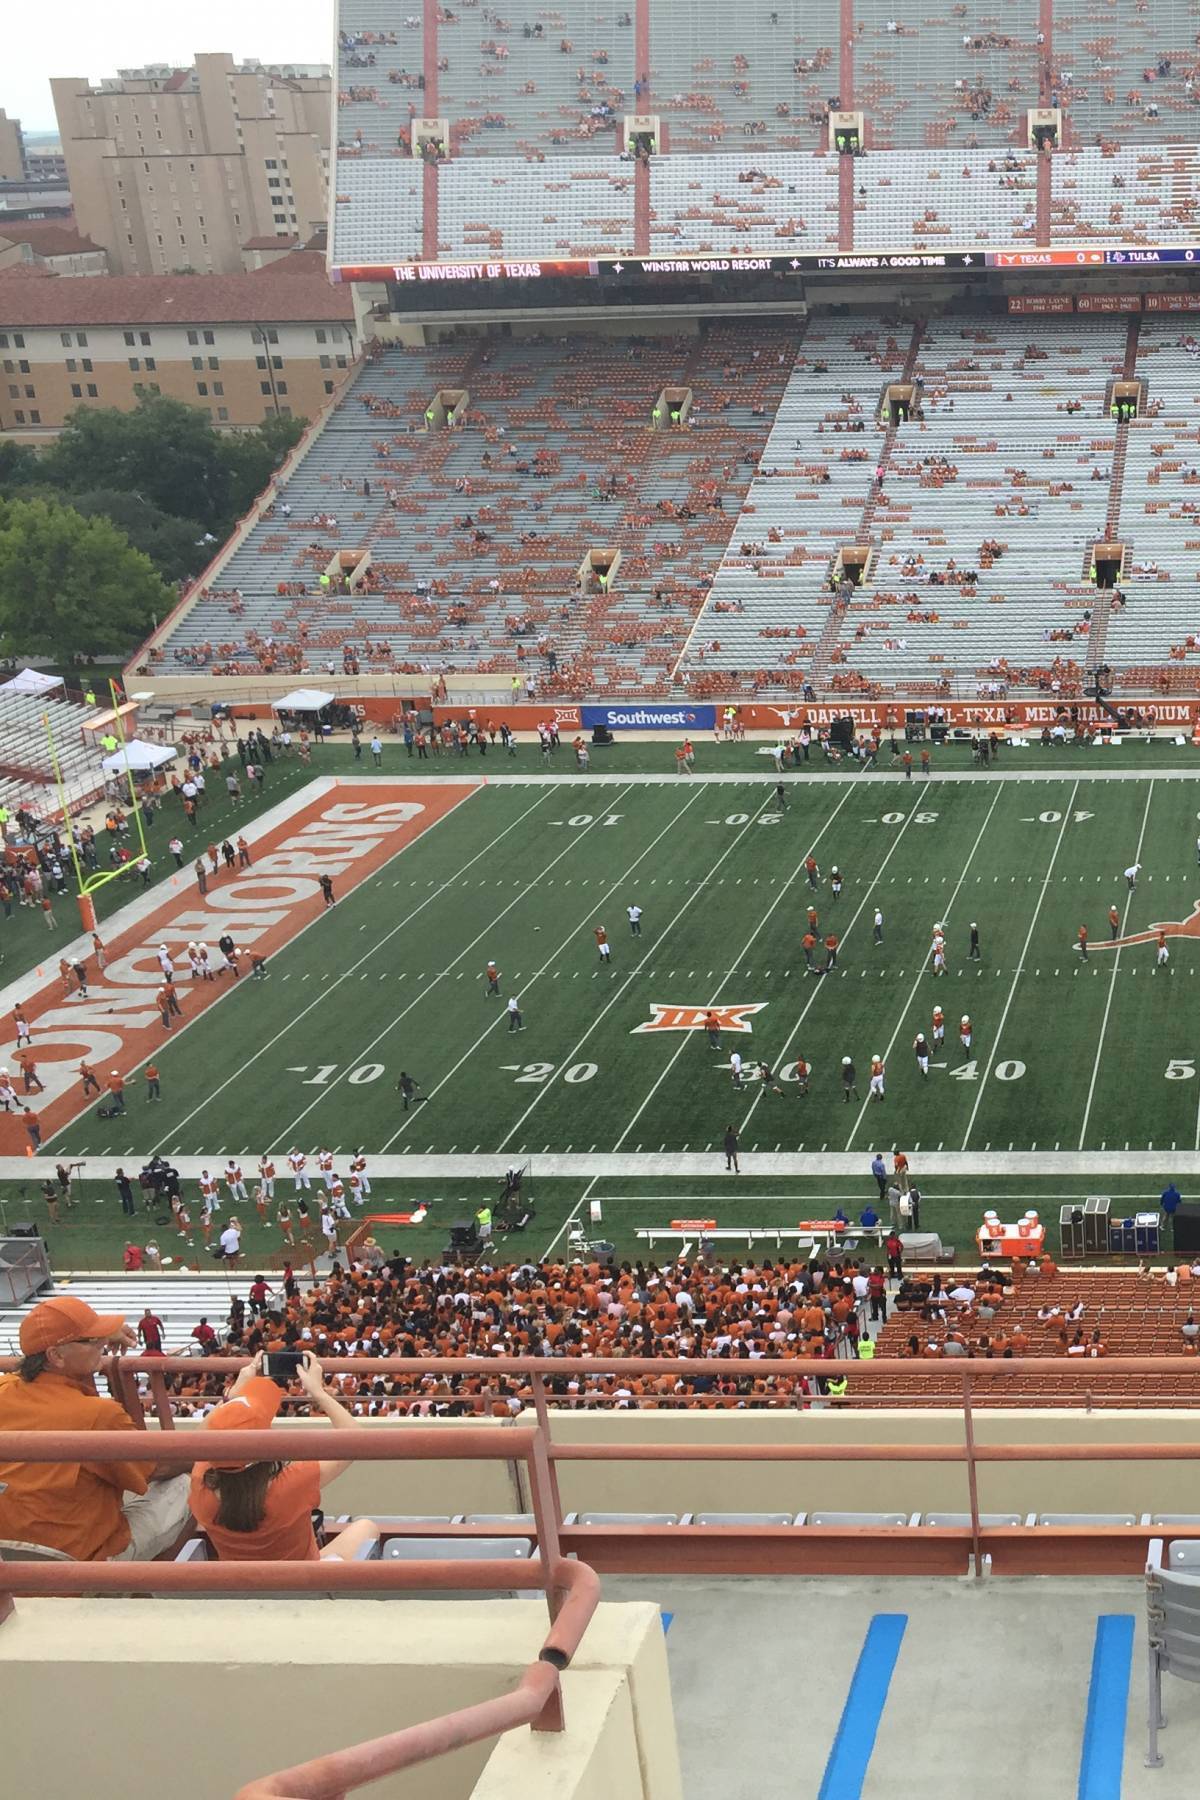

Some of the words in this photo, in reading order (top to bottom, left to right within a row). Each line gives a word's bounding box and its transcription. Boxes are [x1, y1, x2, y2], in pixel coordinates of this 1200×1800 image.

[818, 258, 836, 268] IT'S
[837, 257, 879, 267] ALWAYS
[880, 258, 889, 267] A
[889, 256, 920, 267] GOOD
[920, 256, 945, 266] TIME
[1020, 254, 1052, 263] TEXAS
[1076, 253, 1085, 263] 0
[1128, 252, 1160, 261] TULSA
[1185, 251, 1194, 260] 0
[641, 261, 689, 272] WINSTAR
[691, 260, 730, 271] WORLD
[732, 259, 771, 270] RESORT
[393, 267, 415, 281] THE
[419, 265, 482, 279] UNIVERSITY
[487, 265, 502, 278] OF
[504, 264, 541, 277] TEXAS
[1010, 301, 1021, 310] 22
[1078, 299, 1089, 309] 60
[1148, 298, 1157, 307] 10
[607, 710, 685, 724] Southwest
[1025, 706, 1107, 721] MEMRIAL
[568, 814, 625, 826] 10
[725, 813, 784, 825] 20
[881, 811, 939, 824] 30
[1039, 810, 1095, 823] 40
[303, 1063, 385, 1085] 10
[514, 1062, 598, 1083] 20
[949, 1060, 1027, 1080] 40
